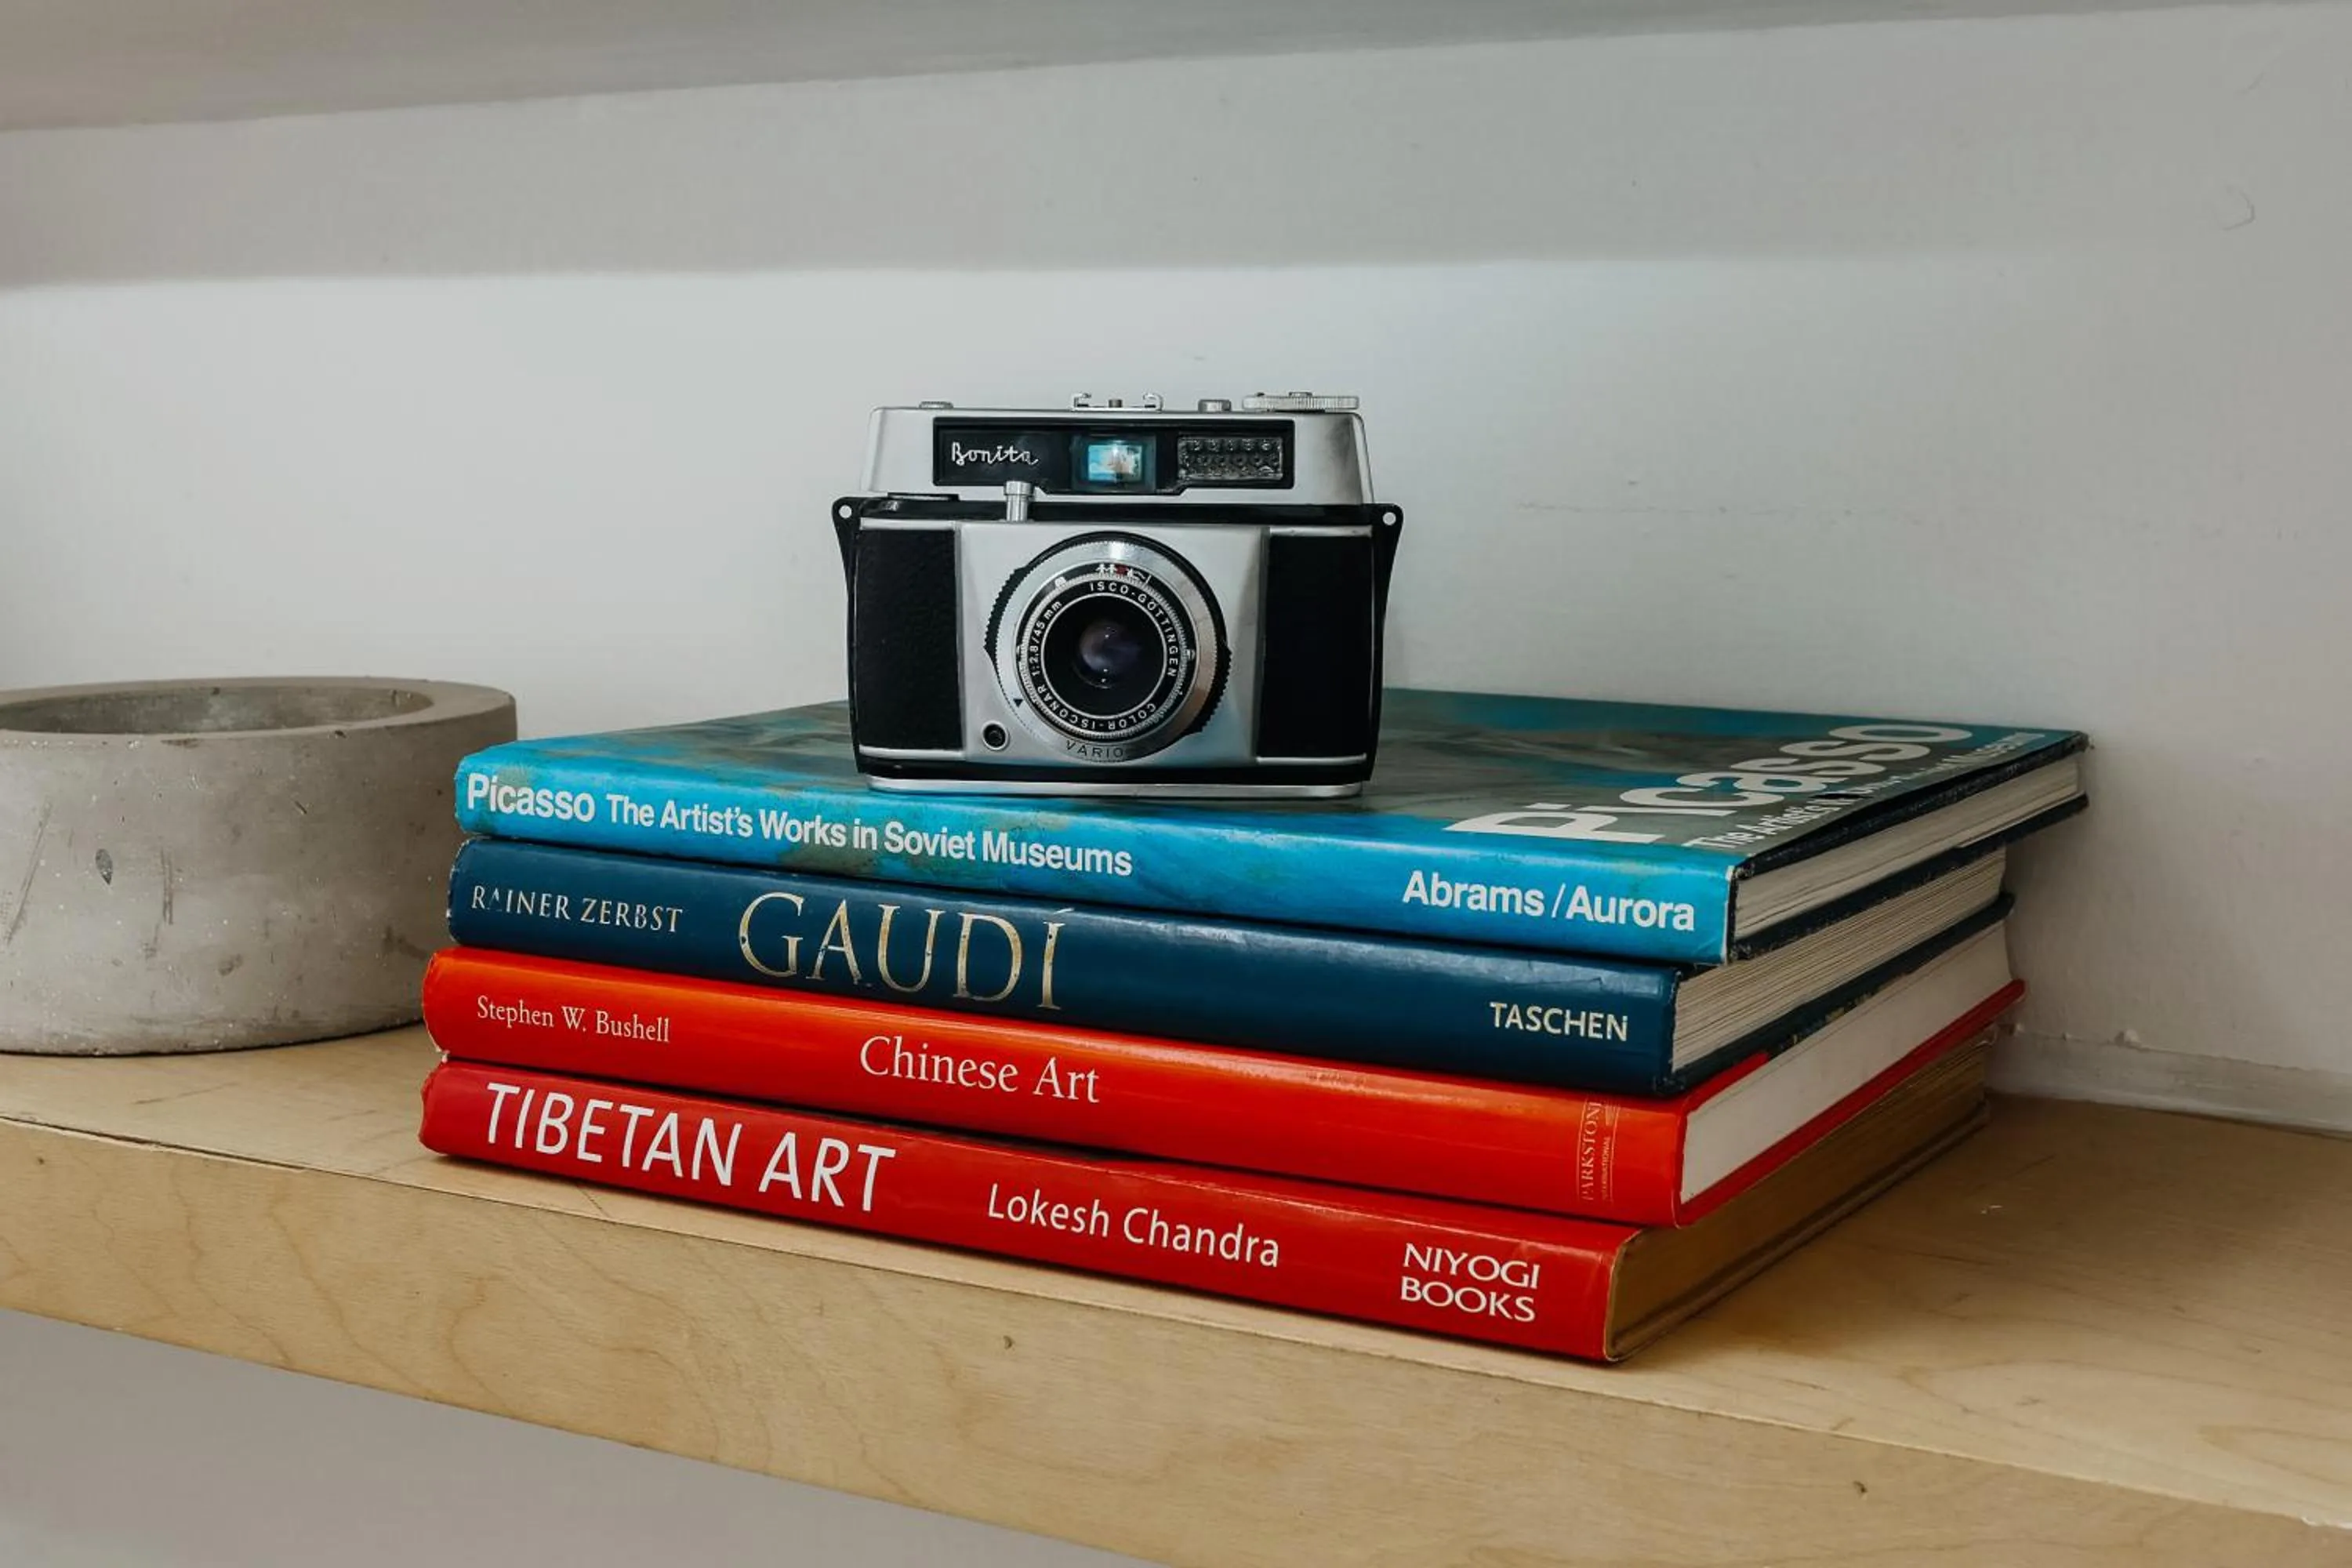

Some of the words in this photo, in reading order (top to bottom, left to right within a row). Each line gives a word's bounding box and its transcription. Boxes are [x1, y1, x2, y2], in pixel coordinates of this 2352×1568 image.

[951, 441, 1039, 466] Bonita
[1036, 685, 1157, 731] COLOR-ISCONAR
[1065, 739, 1124, 759] VARIO
[1441, 724, 1973, 844] Picasso
[466, 772, 596, 823] Picasso
[605, 793, 655, 828] The
[659, 799, 754, 839] Artist's
[759, 808, 848, 848] Works
[853, 817, 878, 851] in
[884, 821, 975, 860] Soviet
[982, 829, 1134, 877] Museums
[471, 884, 571, 921] RAINER
[579, 898, 684, 934] ZERBST
[1402, 869, 1545, 917] Abrams
[739, 891, 1075, 1011] GAUDÍ
[477, 995, 554, 1028] Stephen
[561, 1005, 587, 1033] W.
[595, 1010, 671, 1043] Bushell
[1489, 1000, 1629, 1043] TASCHEN
[859, 1035, 1019, 1093] Chinese
[1033, 1056, 1100, 1104] Art
[486, 1081, 743, 1188] TIBETAN
[757, 1131, 897, 1213] ART
[987, 1182, 1111, 1238] Lokesh
[1122, 1207, 1280, 1269] Chandra
[1403, 1242, 1541, 1290] NIYOGI
[1400, 1275, 1537, 1323] BOOKS
